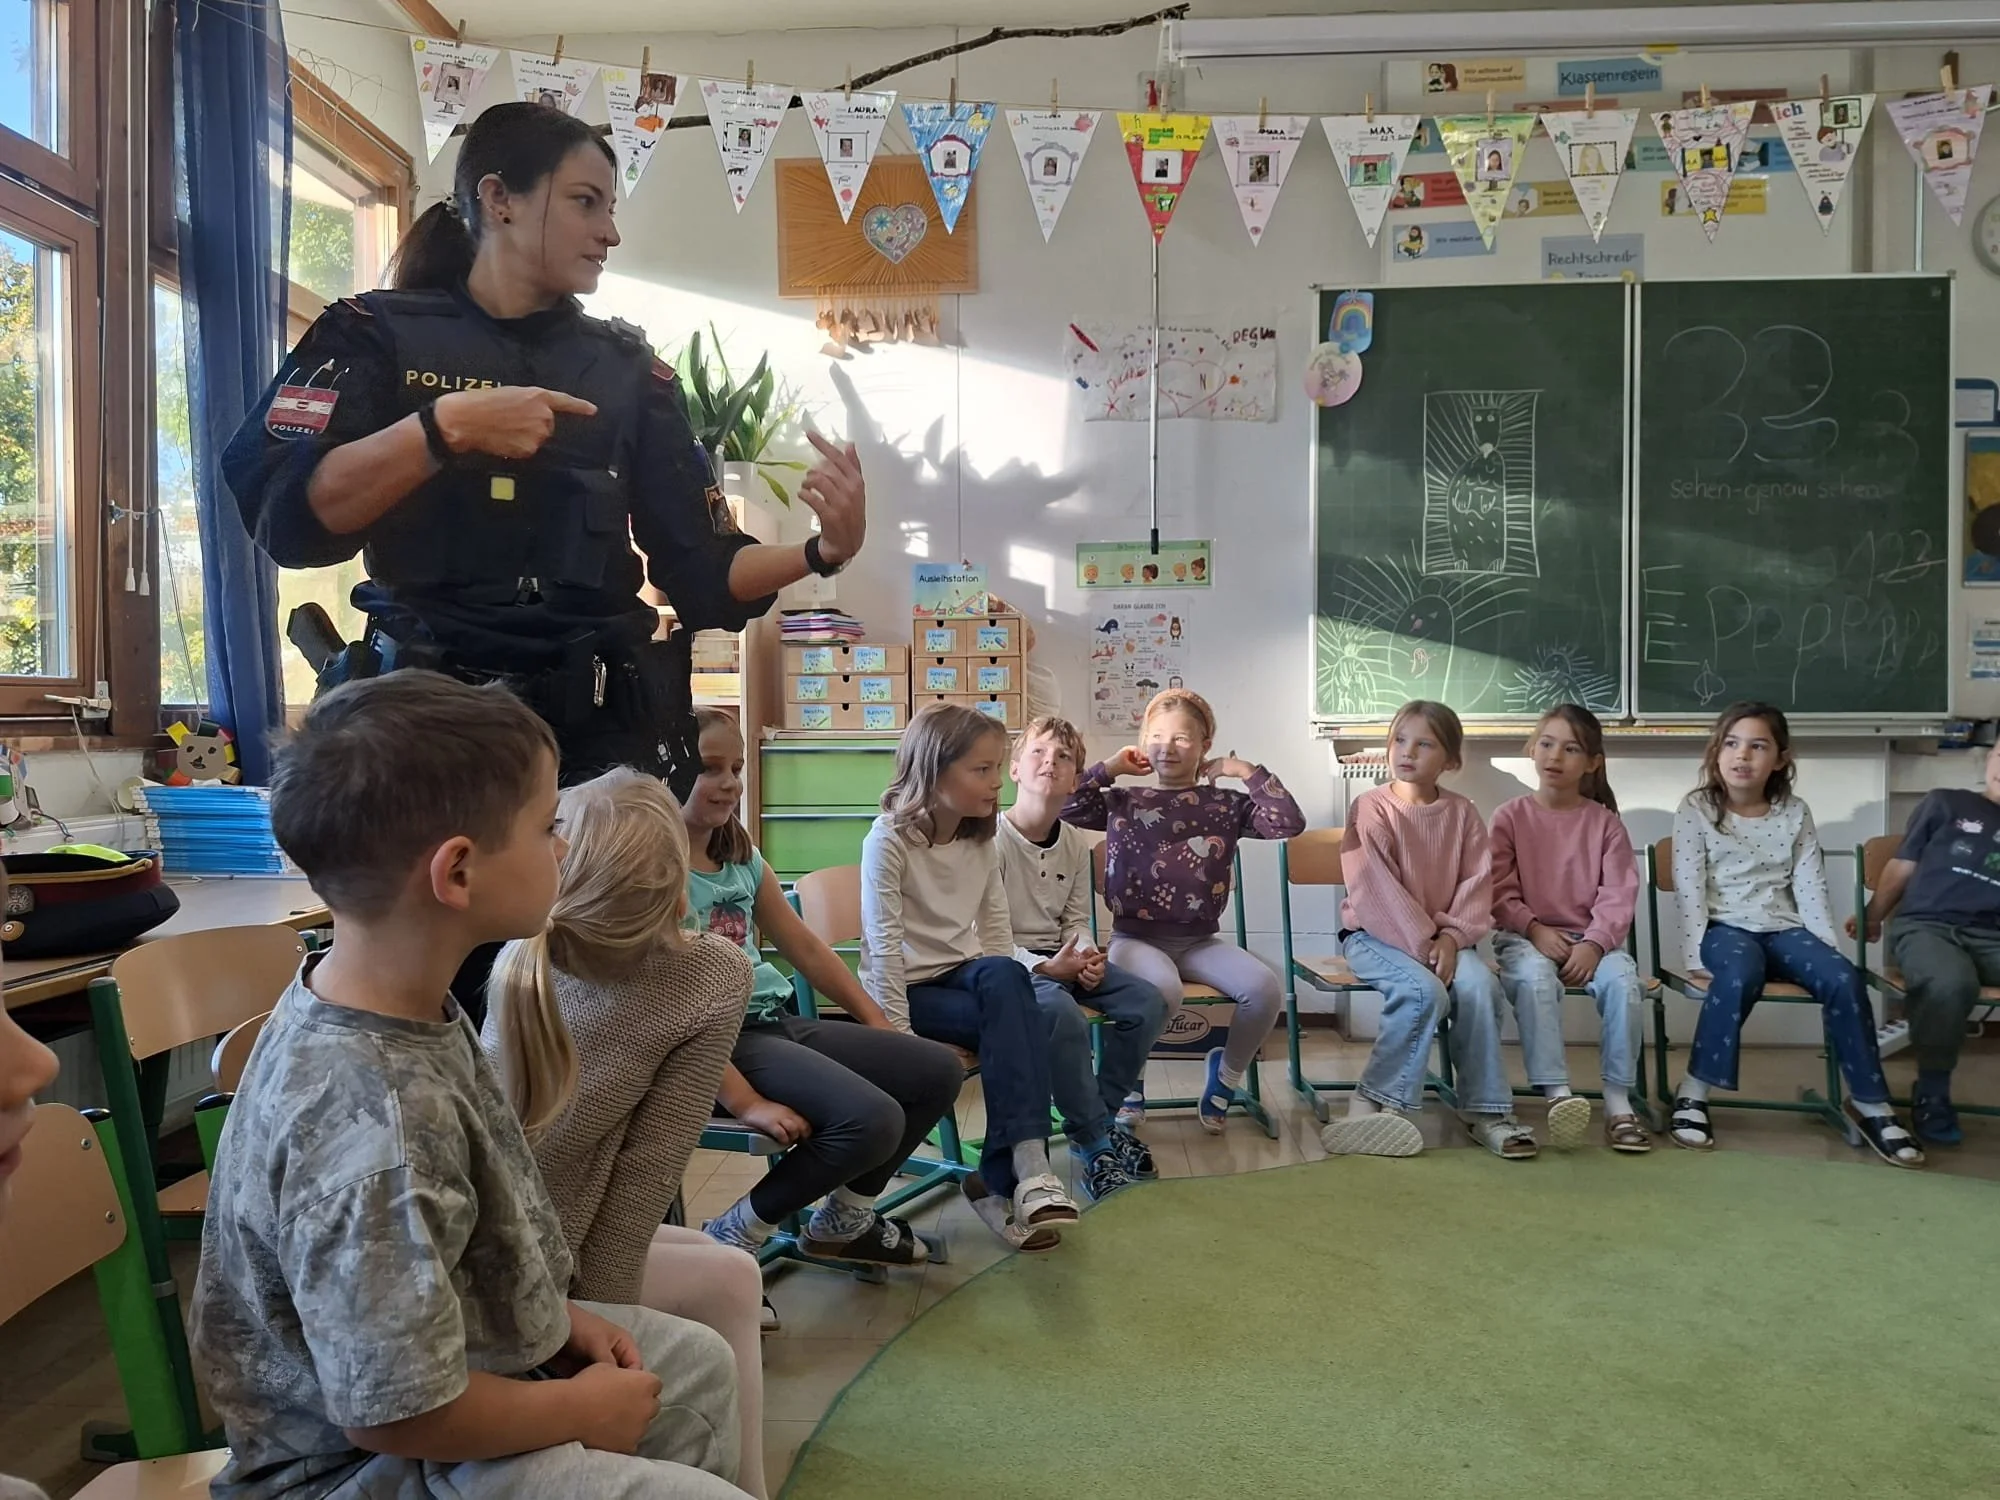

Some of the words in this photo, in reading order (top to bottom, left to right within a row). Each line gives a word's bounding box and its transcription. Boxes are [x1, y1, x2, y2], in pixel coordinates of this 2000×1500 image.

[1560, 67, 1659, 86] Klassenregeln
[847, 106, 879, 114] LAURA
[1369, 126, 1394, 135] MAX
[1548, 250, 1638, 265] Rechtschreib-
[271, 424, 315, 435] POLIZEI
[918, 574, 979, 584] Ausleihstation
[1164, 1014, 1205, 1034] Lucar
